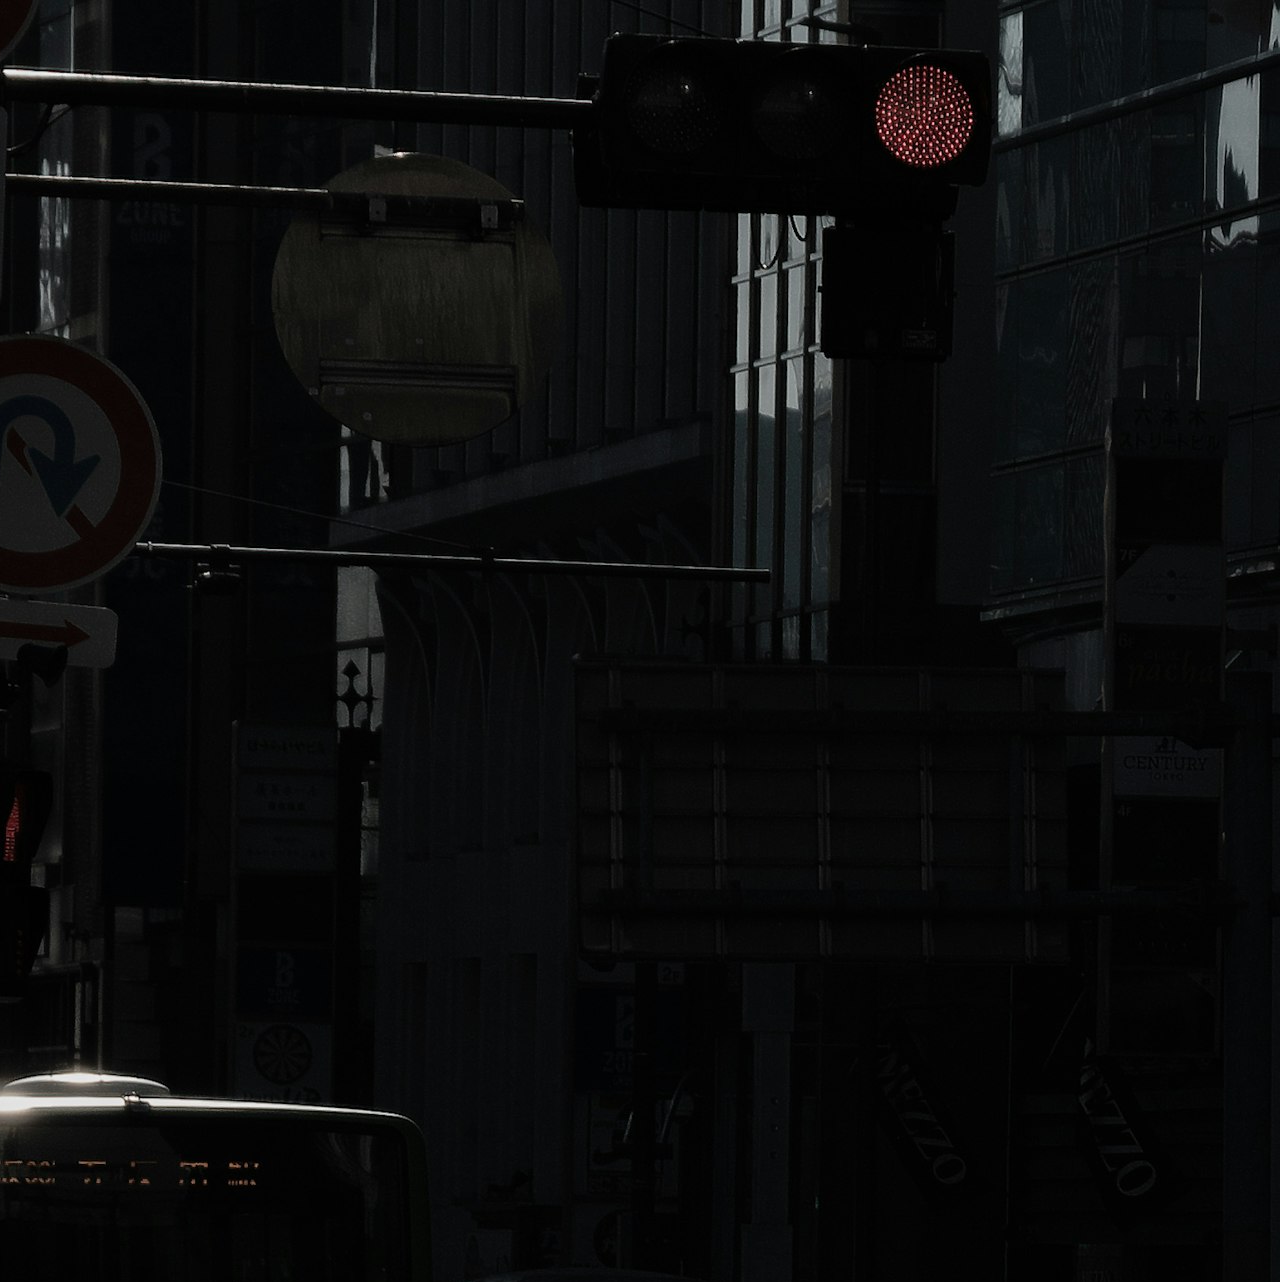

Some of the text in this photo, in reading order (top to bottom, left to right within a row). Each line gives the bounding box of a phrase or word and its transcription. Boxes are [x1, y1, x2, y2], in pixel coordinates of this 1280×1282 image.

[1134, 406, 1207, 427] 六本木
[1123, 755, 1208, 771] CENTURY
